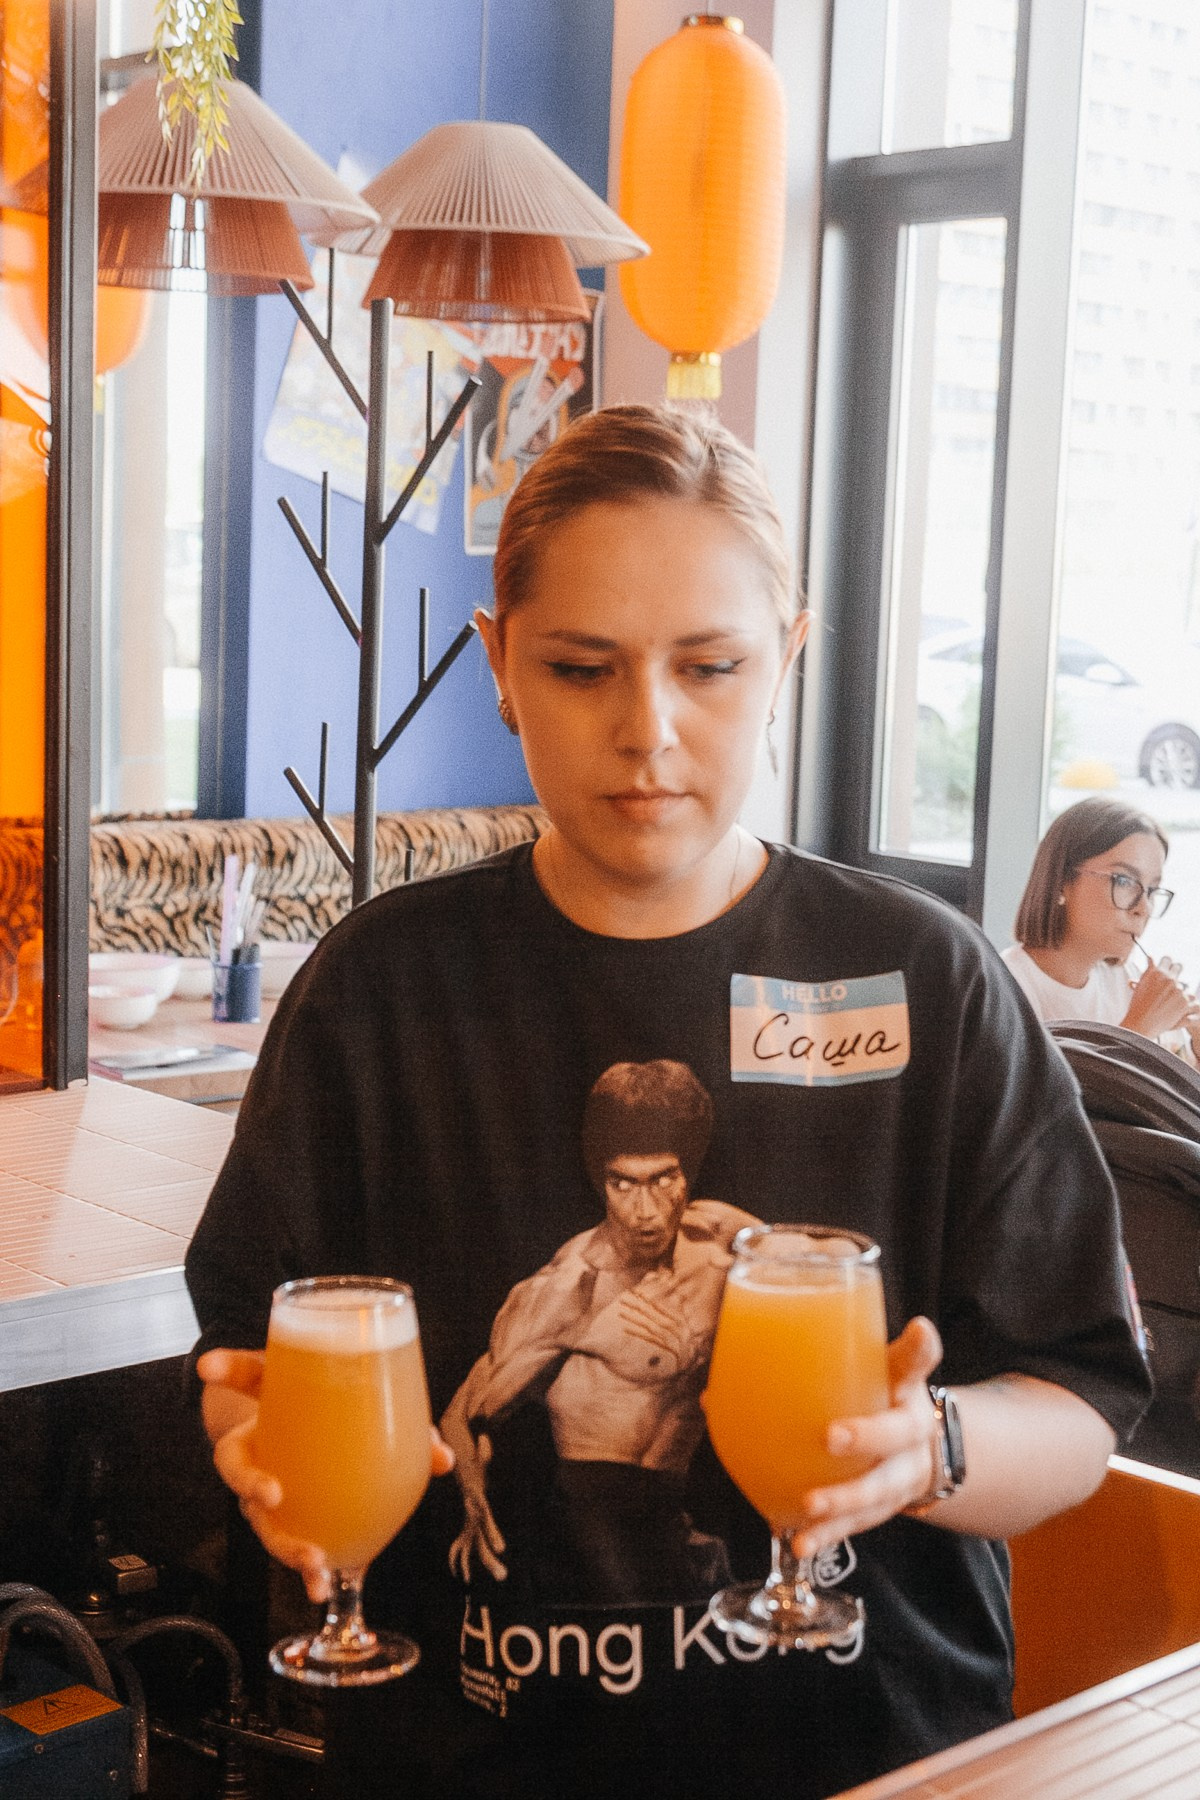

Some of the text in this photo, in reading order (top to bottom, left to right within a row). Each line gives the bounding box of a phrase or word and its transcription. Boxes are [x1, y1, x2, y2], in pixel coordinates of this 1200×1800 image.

[781, 983, 846, 1003] HELLO
[753, 1013, 900, 1065] Саша
[460, 1597, 643, 1695] Hong
[673, 1597, 867, 1671] Kog
